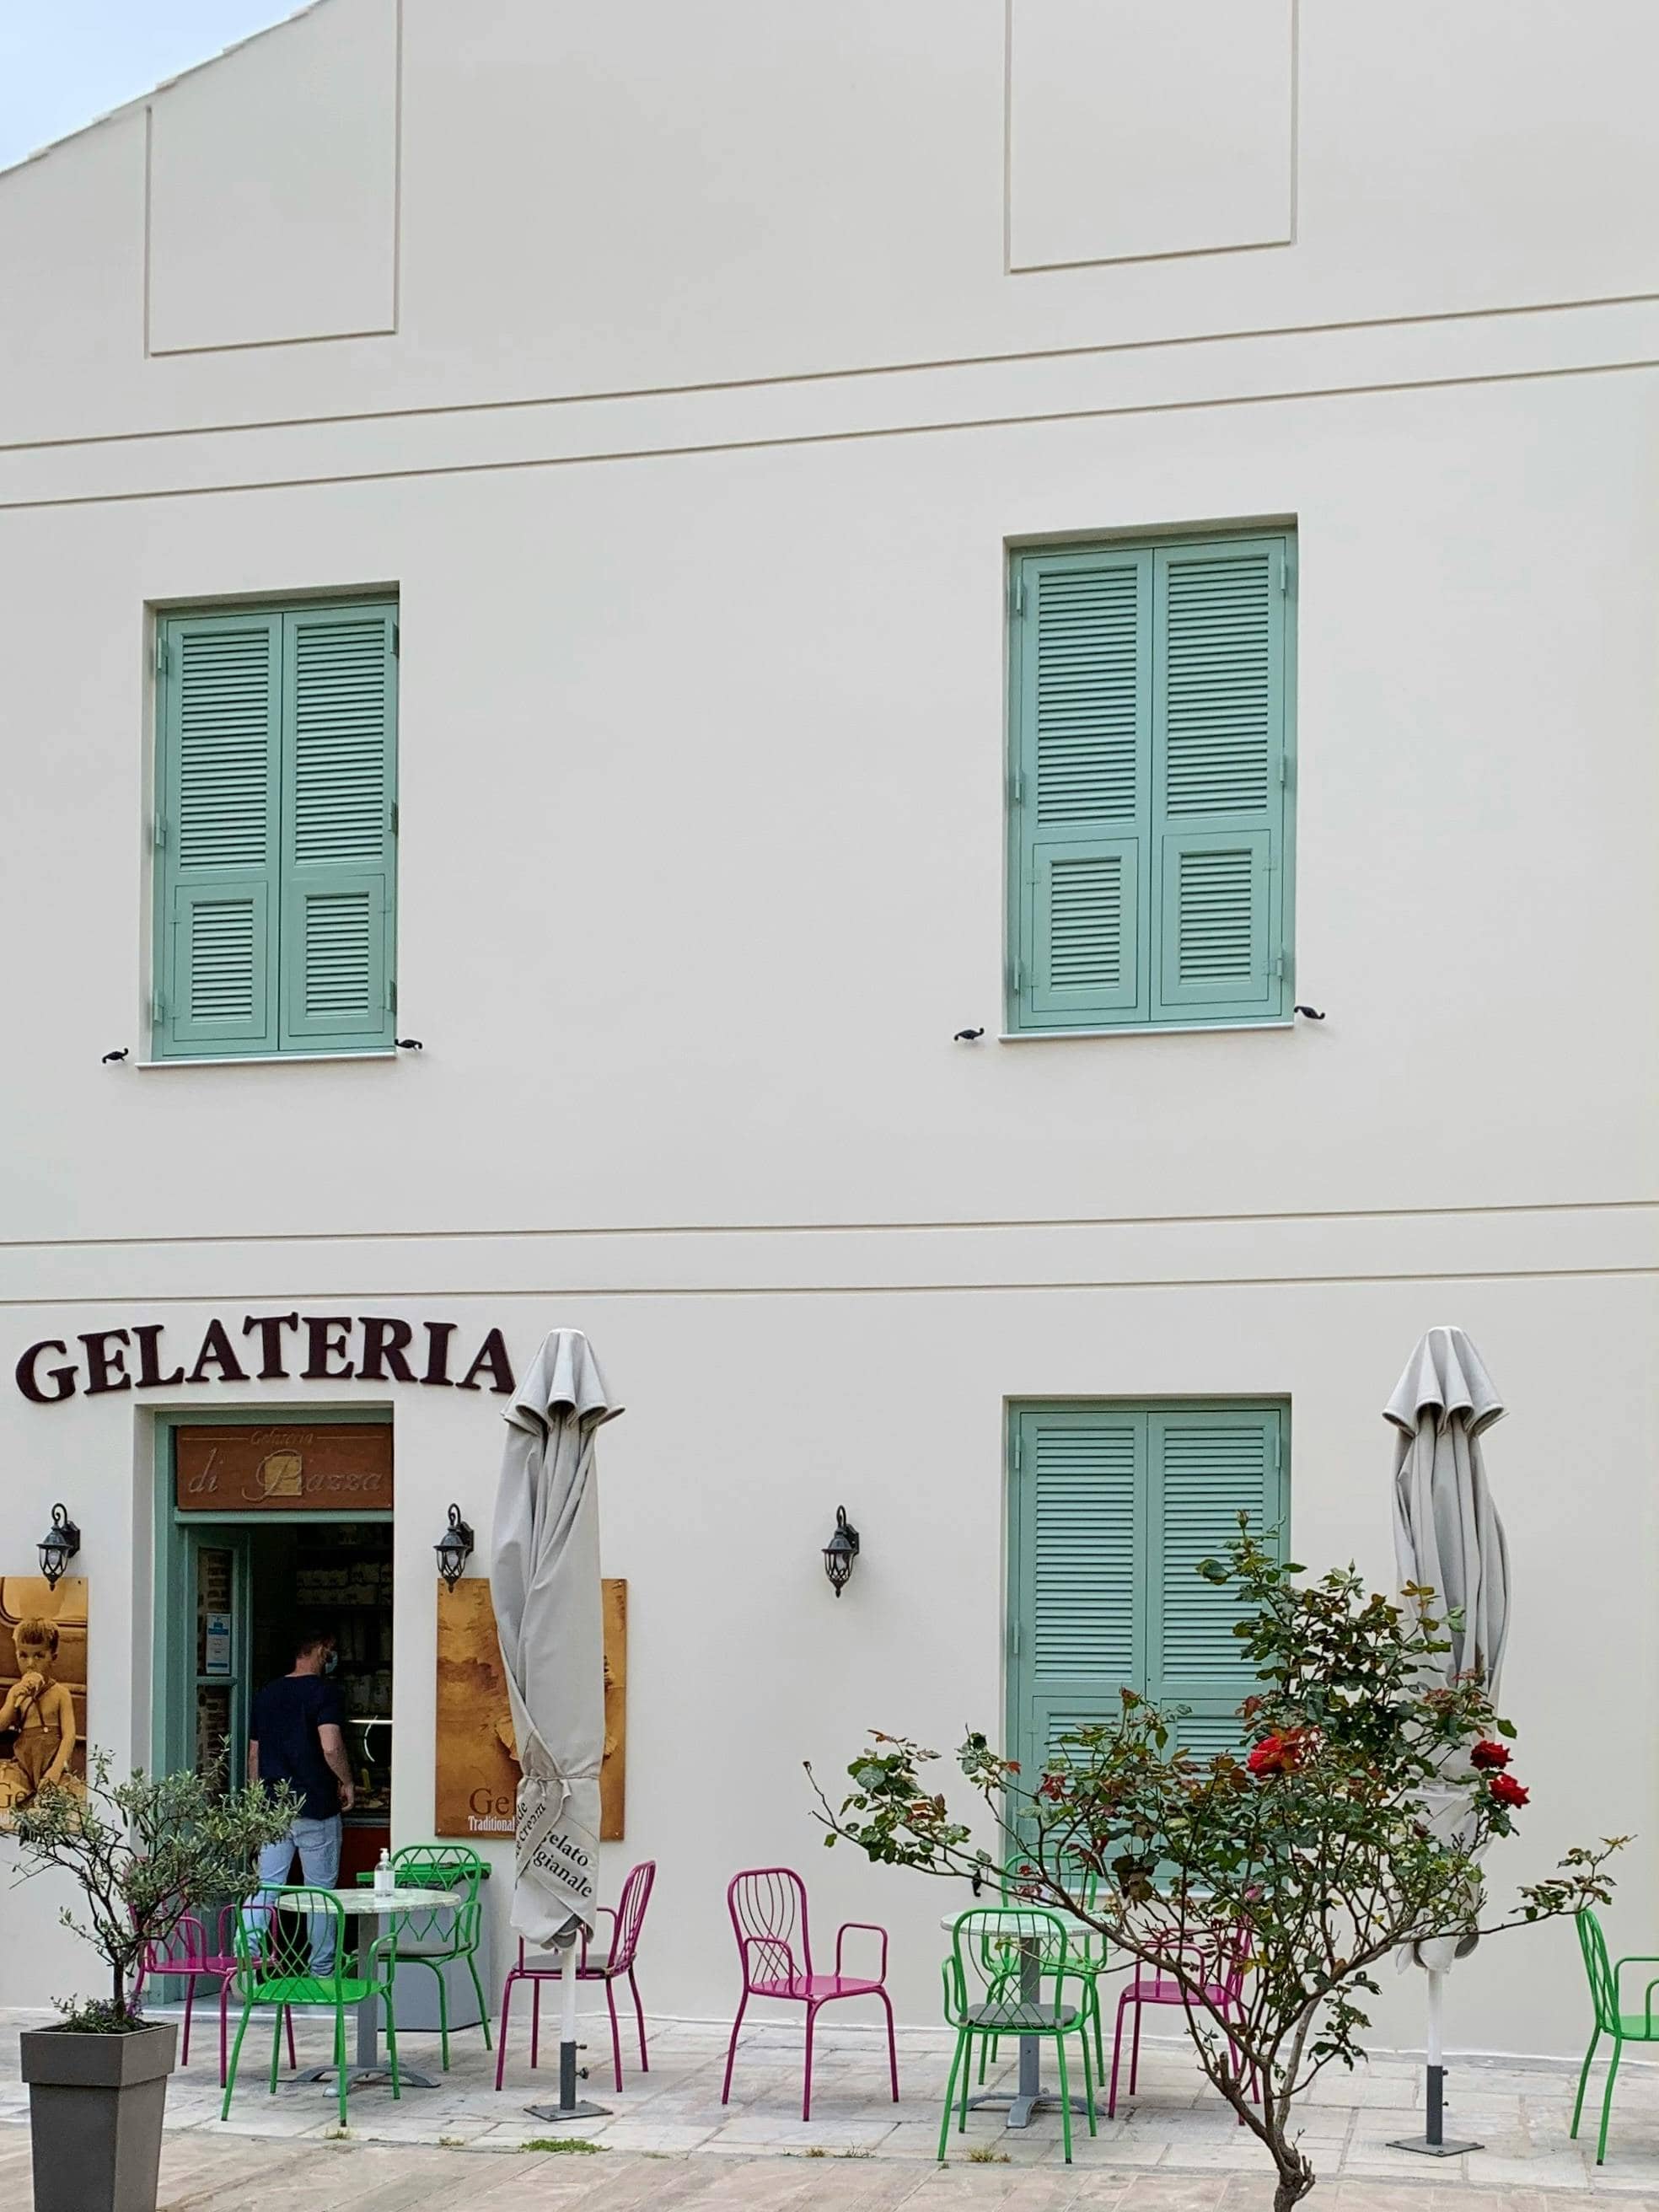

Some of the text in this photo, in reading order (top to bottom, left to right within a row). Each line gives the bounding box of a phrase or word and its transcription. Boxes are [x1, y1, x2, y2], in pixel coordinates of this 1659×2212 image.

[15, 1312, 516, 1403] GELATERIA
[189, 1447, 223, 1493] di
[468, 1815, 515, 1832] Traditional
